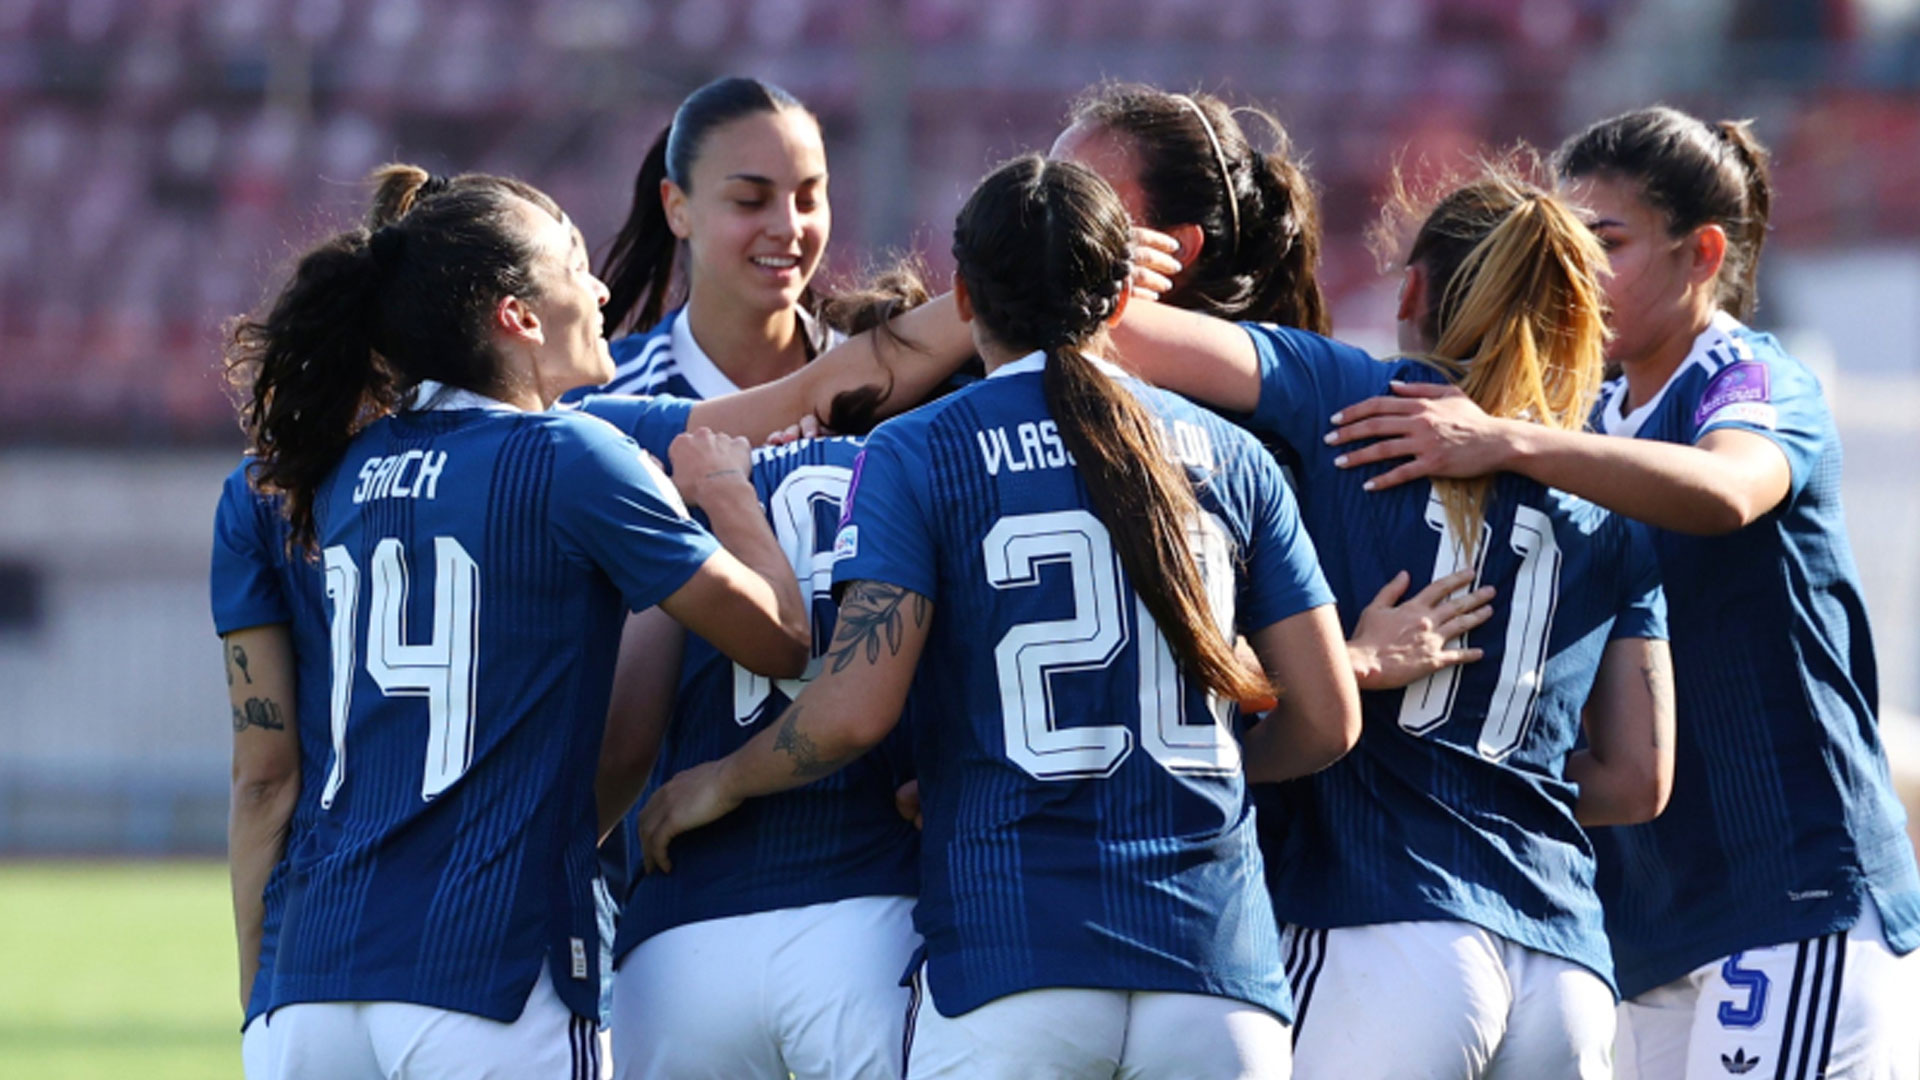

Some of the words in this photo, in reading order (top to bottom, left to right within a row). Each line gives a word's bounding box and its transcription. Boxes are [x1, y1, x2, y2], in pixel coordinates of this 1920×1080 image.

[319, 535, 480, 810] 14
[1398, 480, 1562, 764] 11
[1716, 951, 1770, 1030] 5
